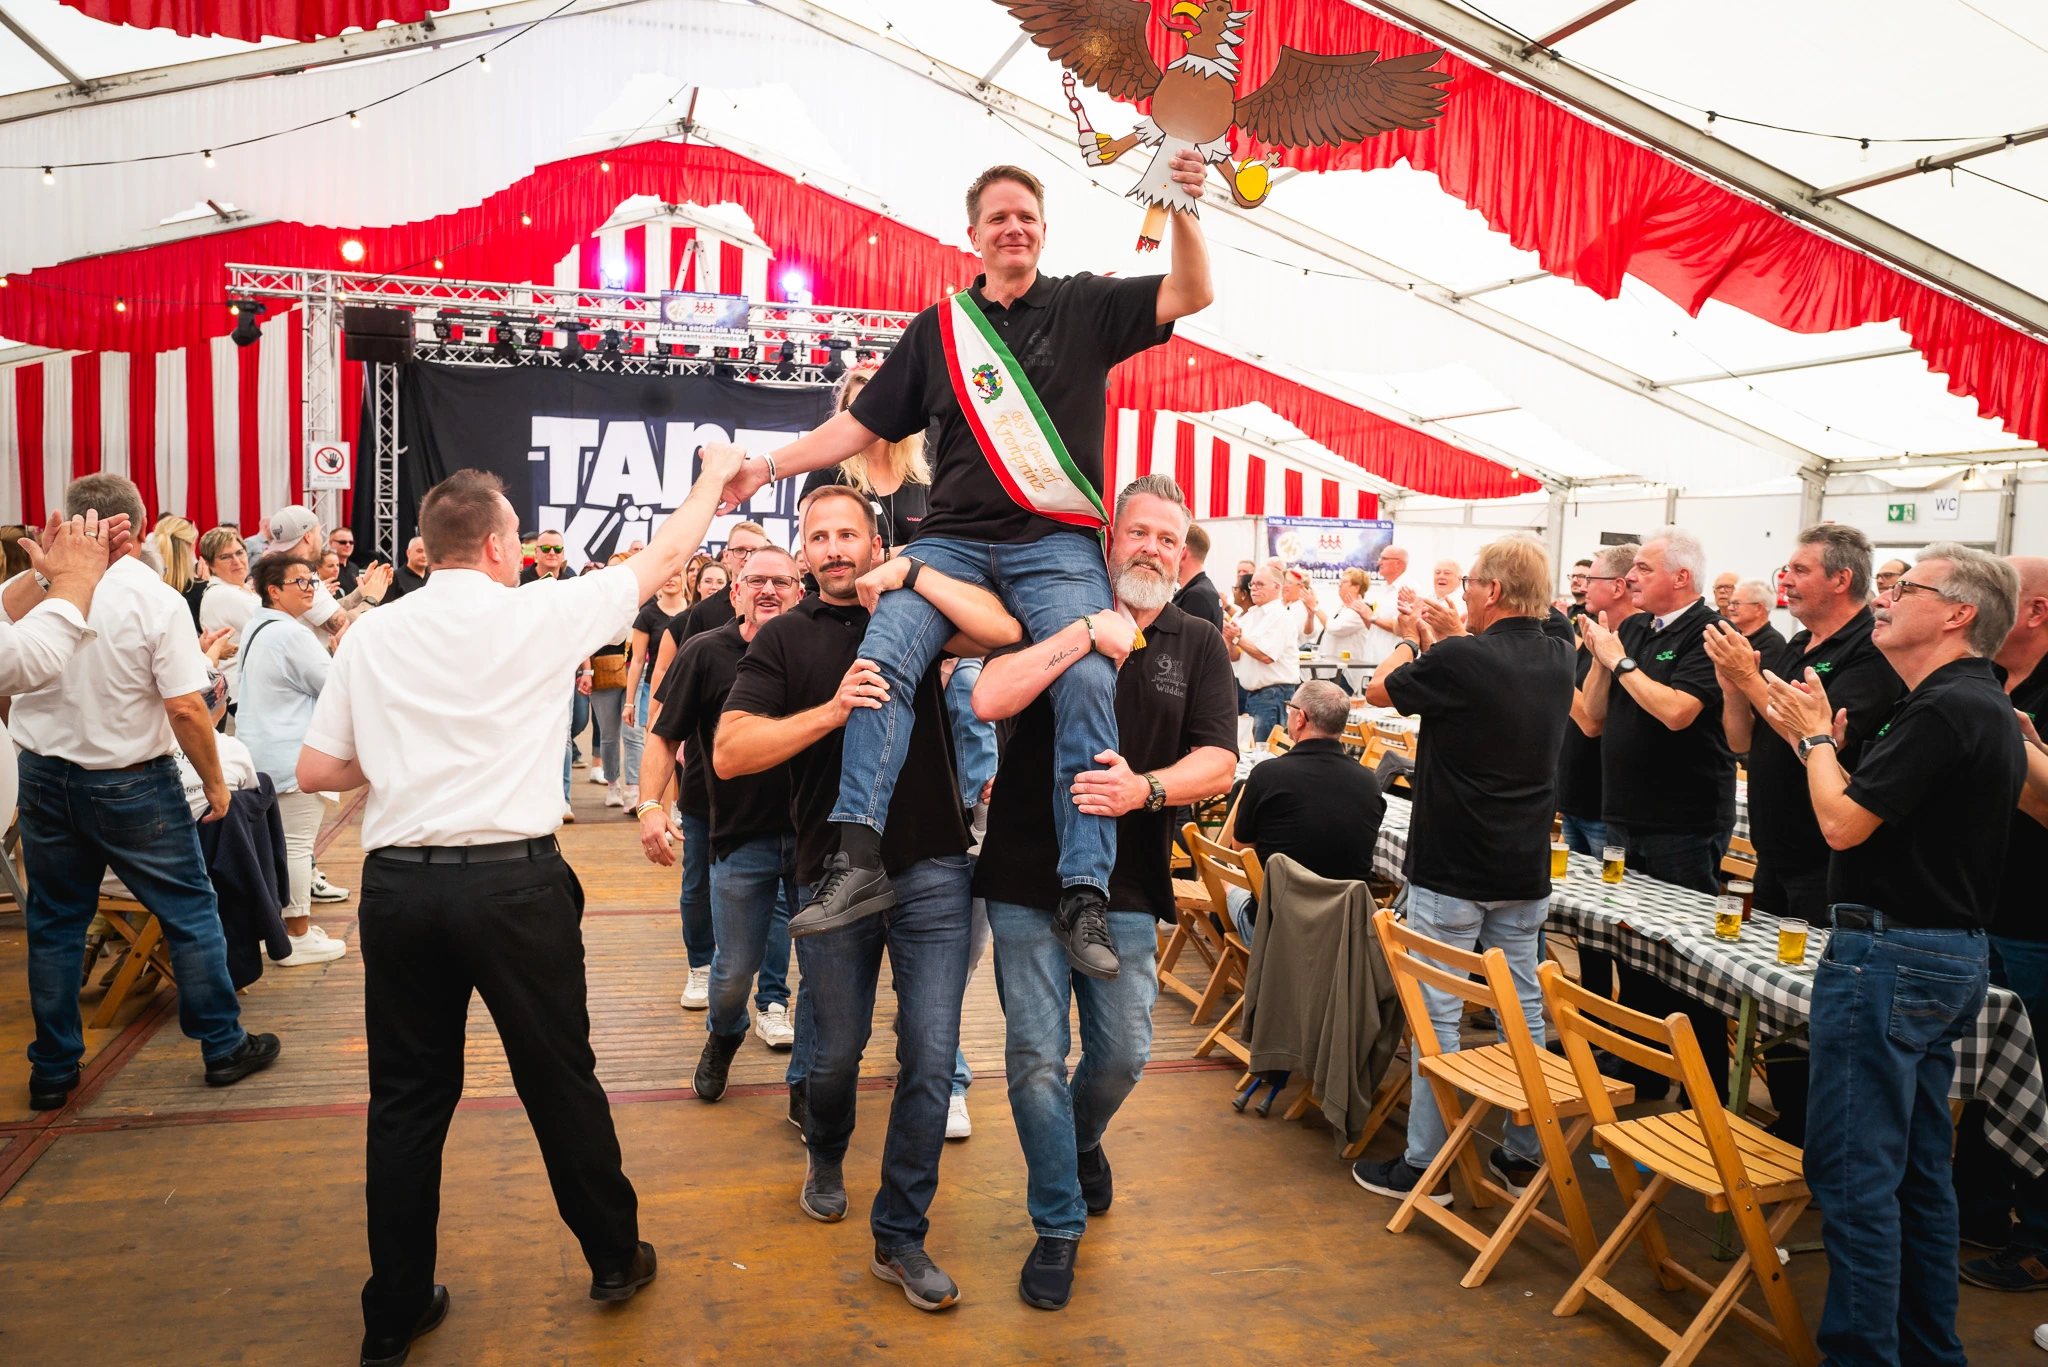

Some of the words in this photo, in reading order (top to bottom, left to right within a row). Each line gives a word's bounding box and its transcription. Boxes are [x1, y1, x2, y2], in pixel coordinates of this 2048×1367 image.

[993, 414, 1047, 492] Kronprinz
[1011, 411, 1037, 438] BSV
[1024, 441, 1064, 484] Gustorf
[1936, 498, 1957, 511] WC
